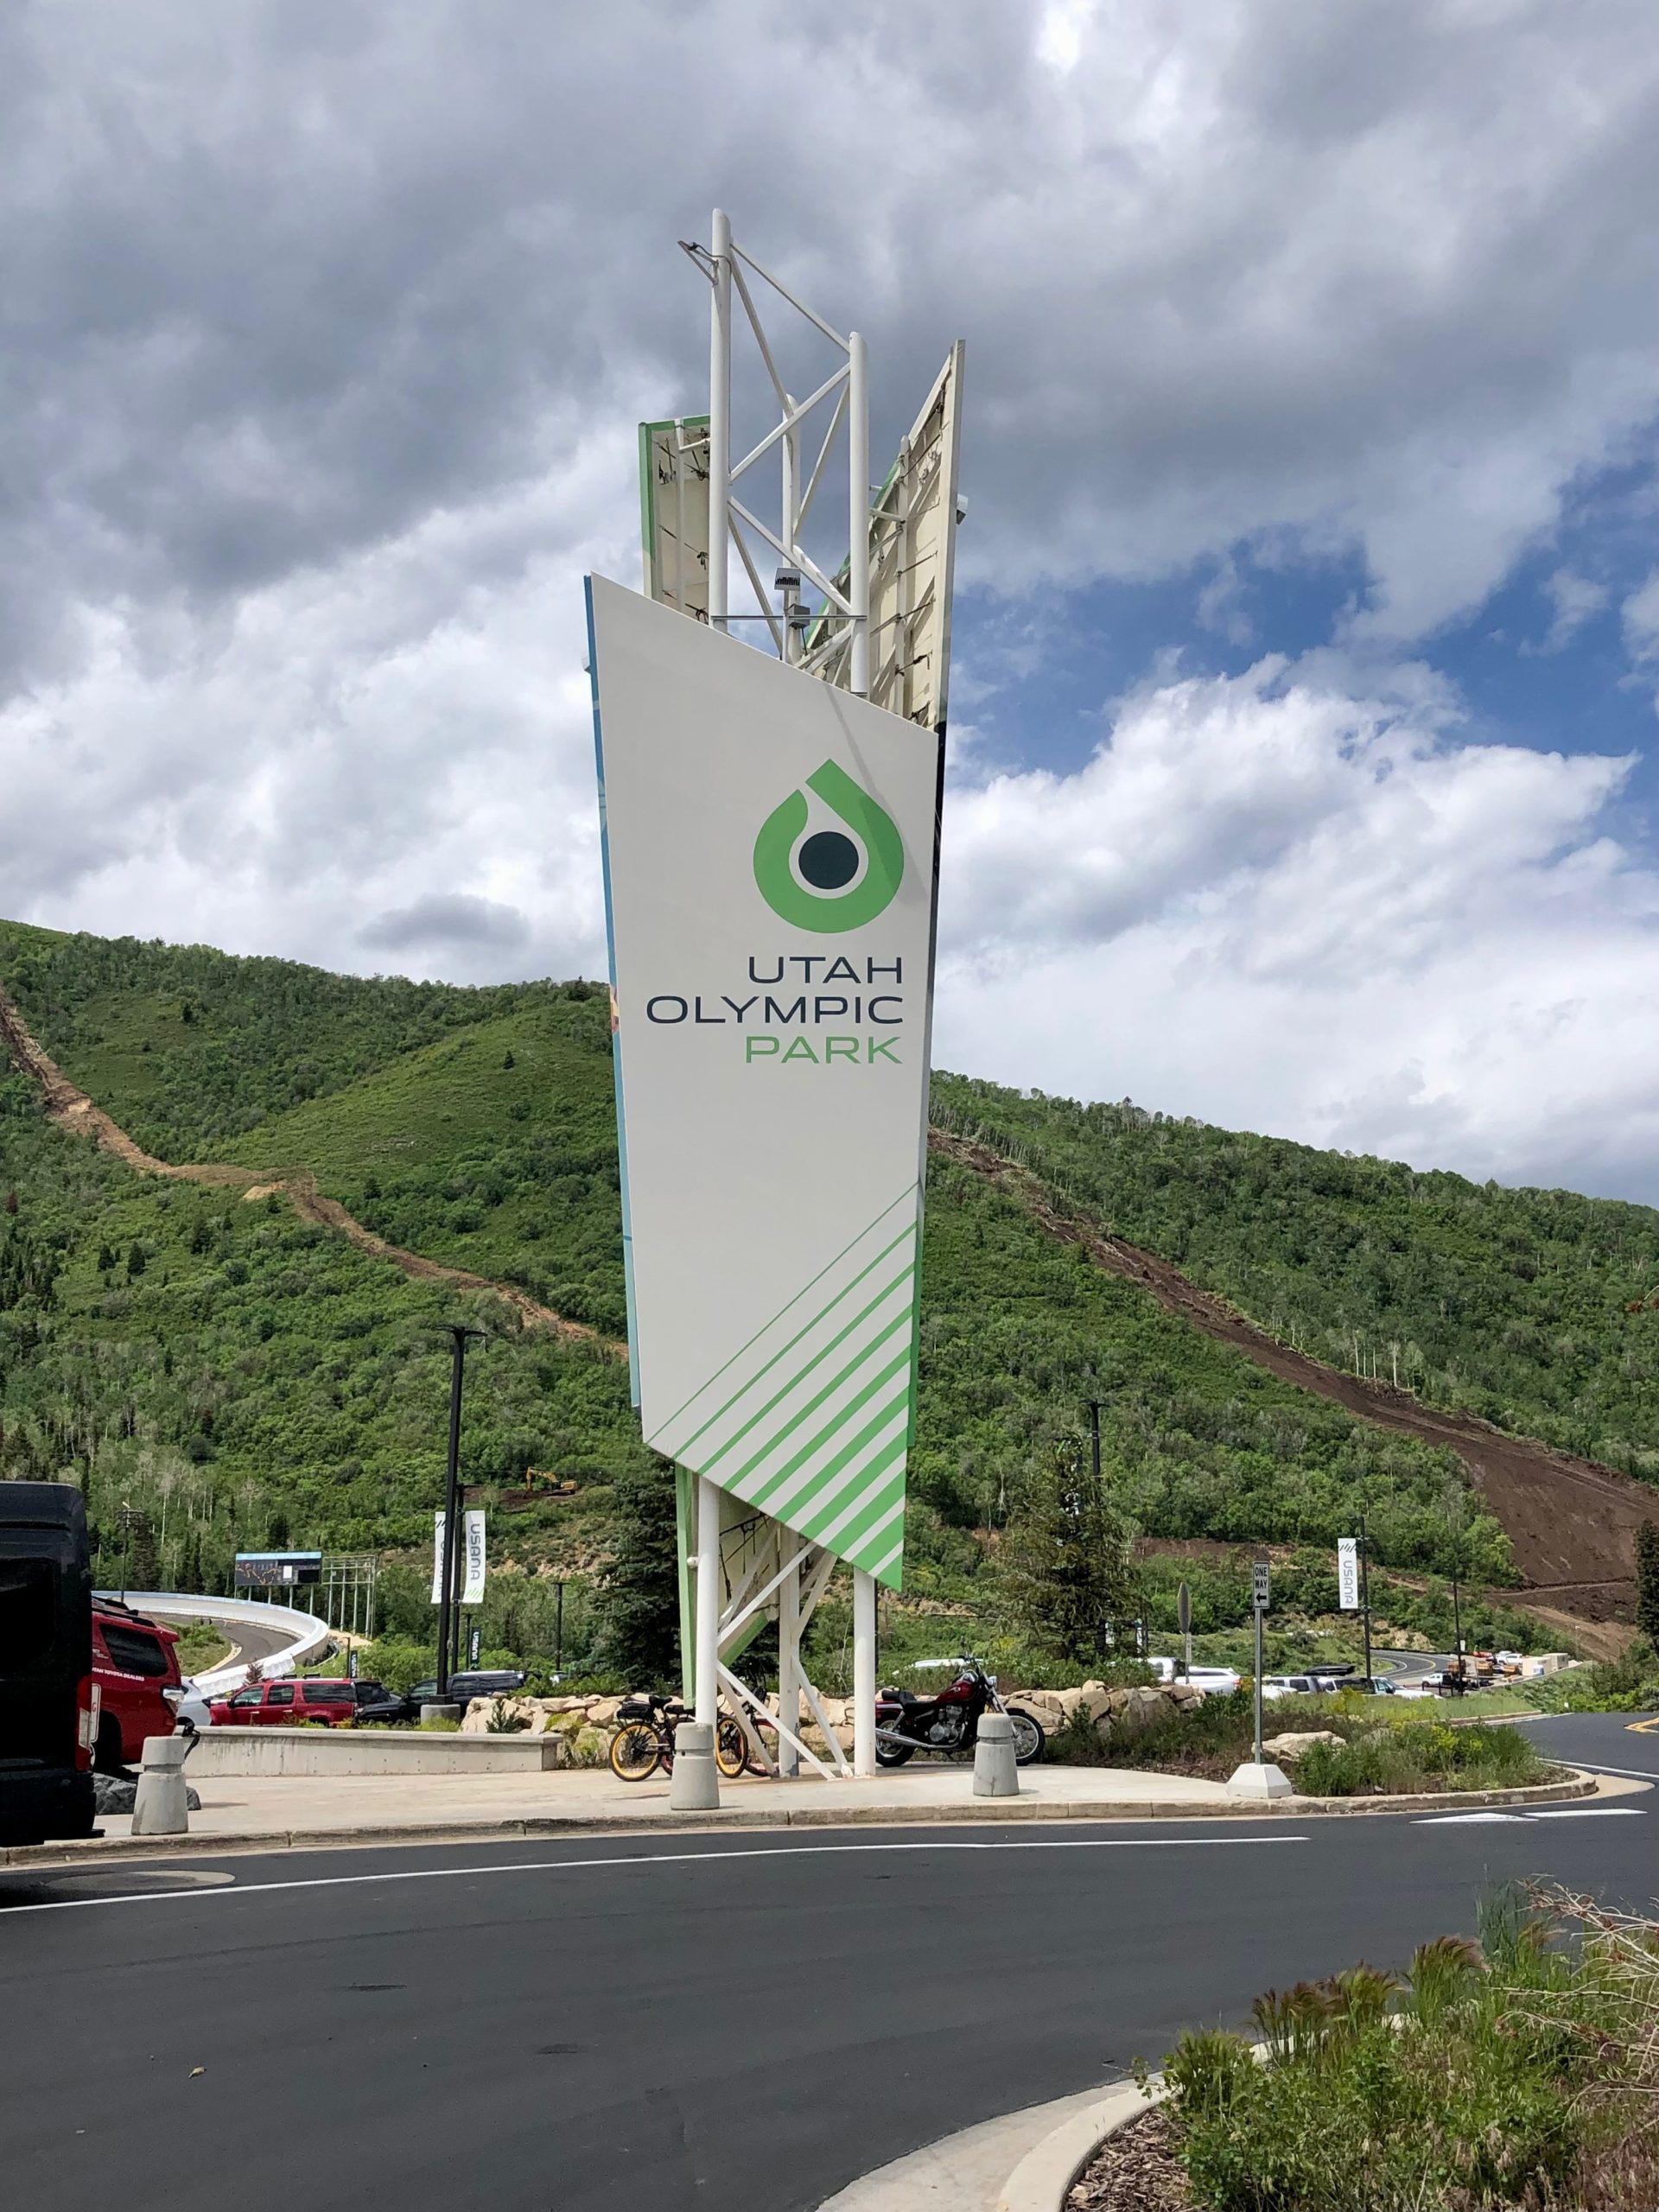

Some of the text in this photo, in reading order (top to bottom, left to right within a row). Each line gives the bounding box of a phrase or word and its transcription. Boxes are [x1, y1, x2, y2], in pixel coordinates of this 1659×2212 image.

[749, 957, 903, 984] UTAH
[646, 995, 904, 1024] OLYMPIC
[746, 1036, 904, 1065] PARK
[470, 1523, 480, 1580] USANA
[1255, 1567, 1267, 1577] ONE
[1255, 1580, 1267, 1589] WAY
[1344, 1560, 1354, 1604] USANA
